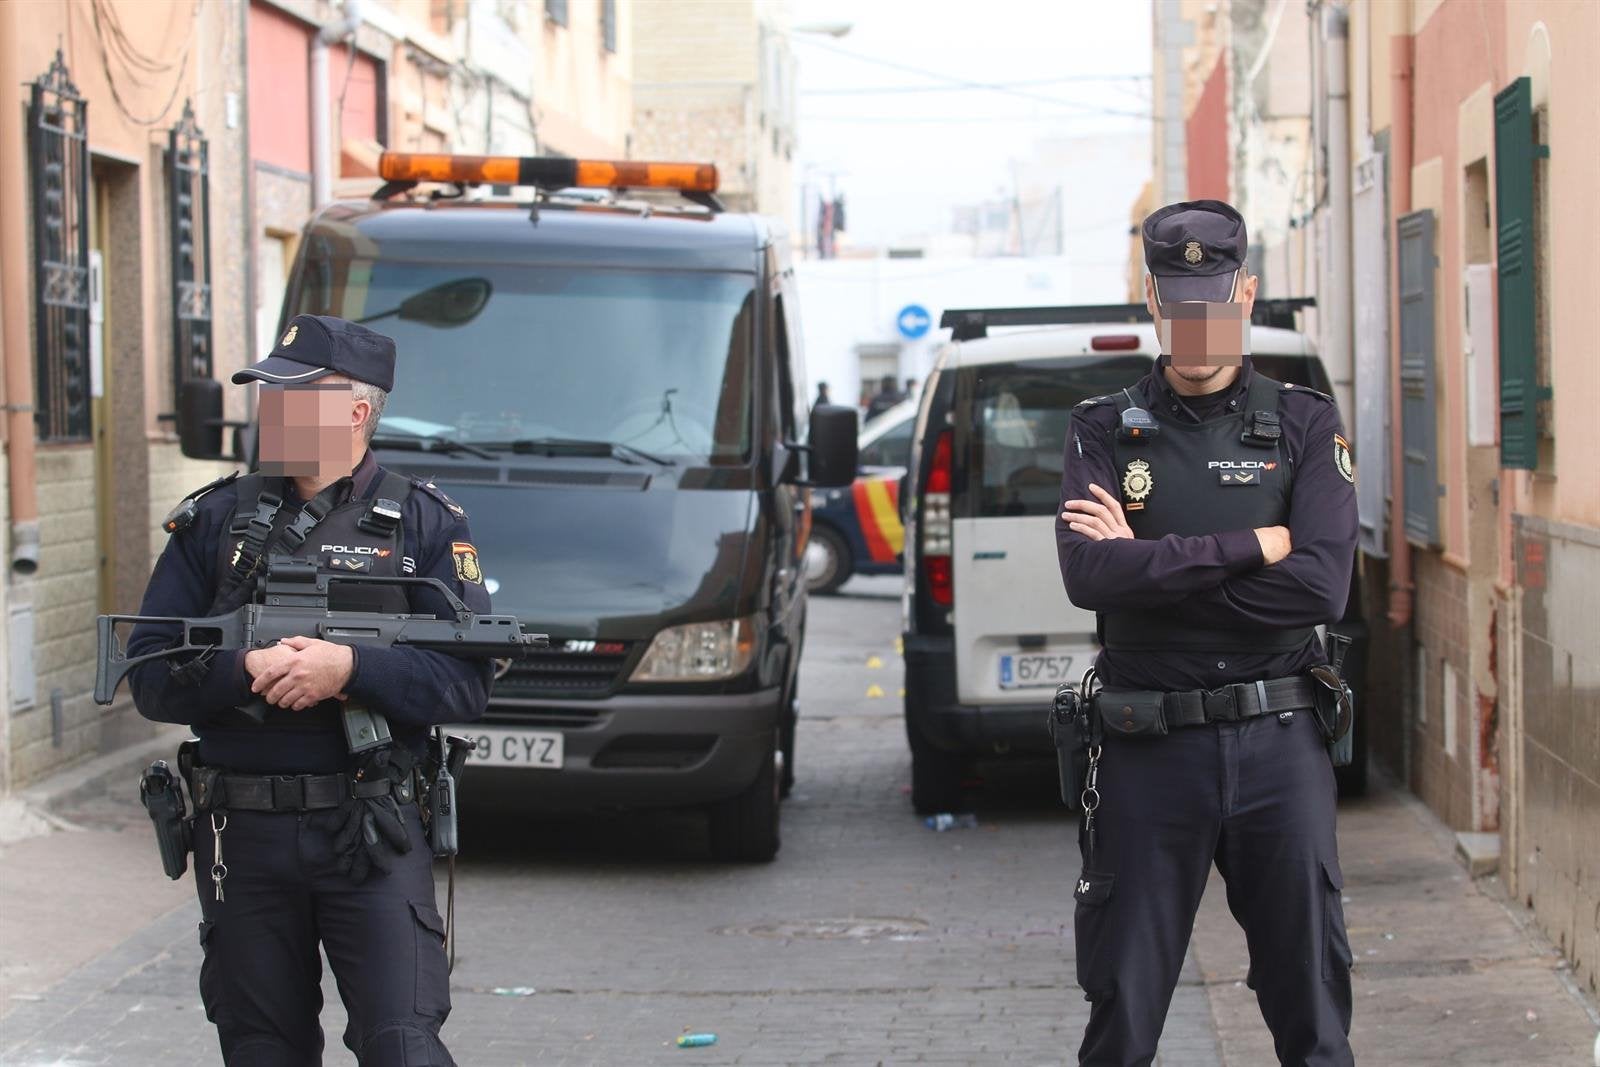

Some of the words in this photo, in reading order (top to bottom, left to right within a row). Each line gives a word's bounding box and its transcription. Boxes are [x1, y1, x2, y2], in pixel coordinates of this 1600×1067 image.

[1207, 460, 1267, 470] POLICIA
[320, 544, 381, 556] POLICIA
[1018, 655, 1074, 680] 6757
[502, 736, 556, 763] CYZ
